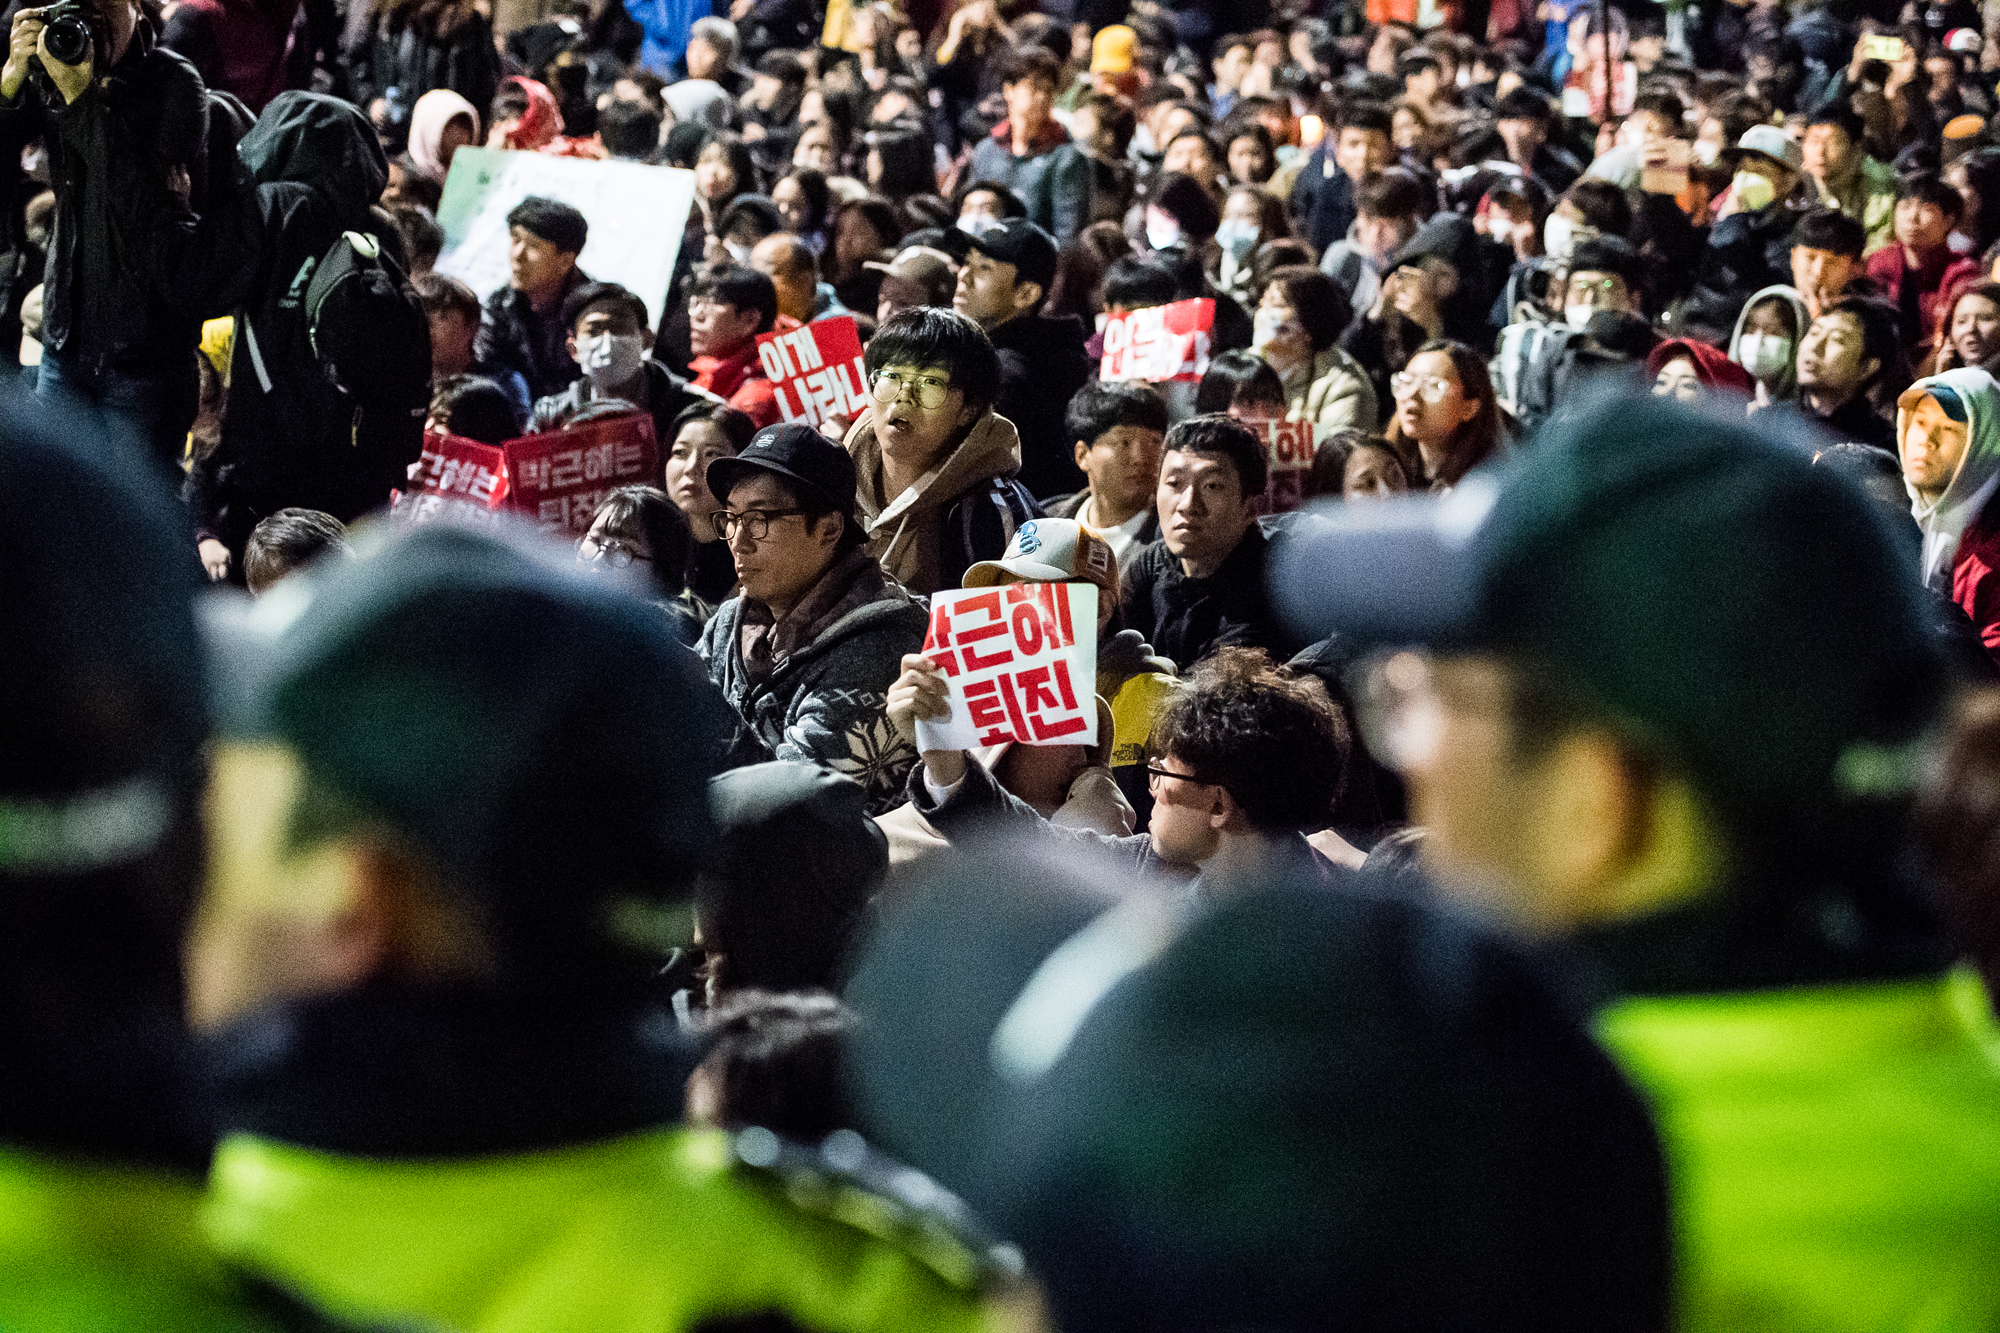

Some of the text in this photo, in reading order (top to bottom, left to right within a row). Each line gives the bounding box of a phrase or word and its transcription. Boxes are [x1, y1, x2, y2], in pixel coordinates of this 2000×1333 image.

[759, 325, 823, 383] 이게
[421, 450, 499, 501] 근혜는
[518, 442, 642, 491] 박근혜는
[962, 658, 1089, 748] 퇴진
